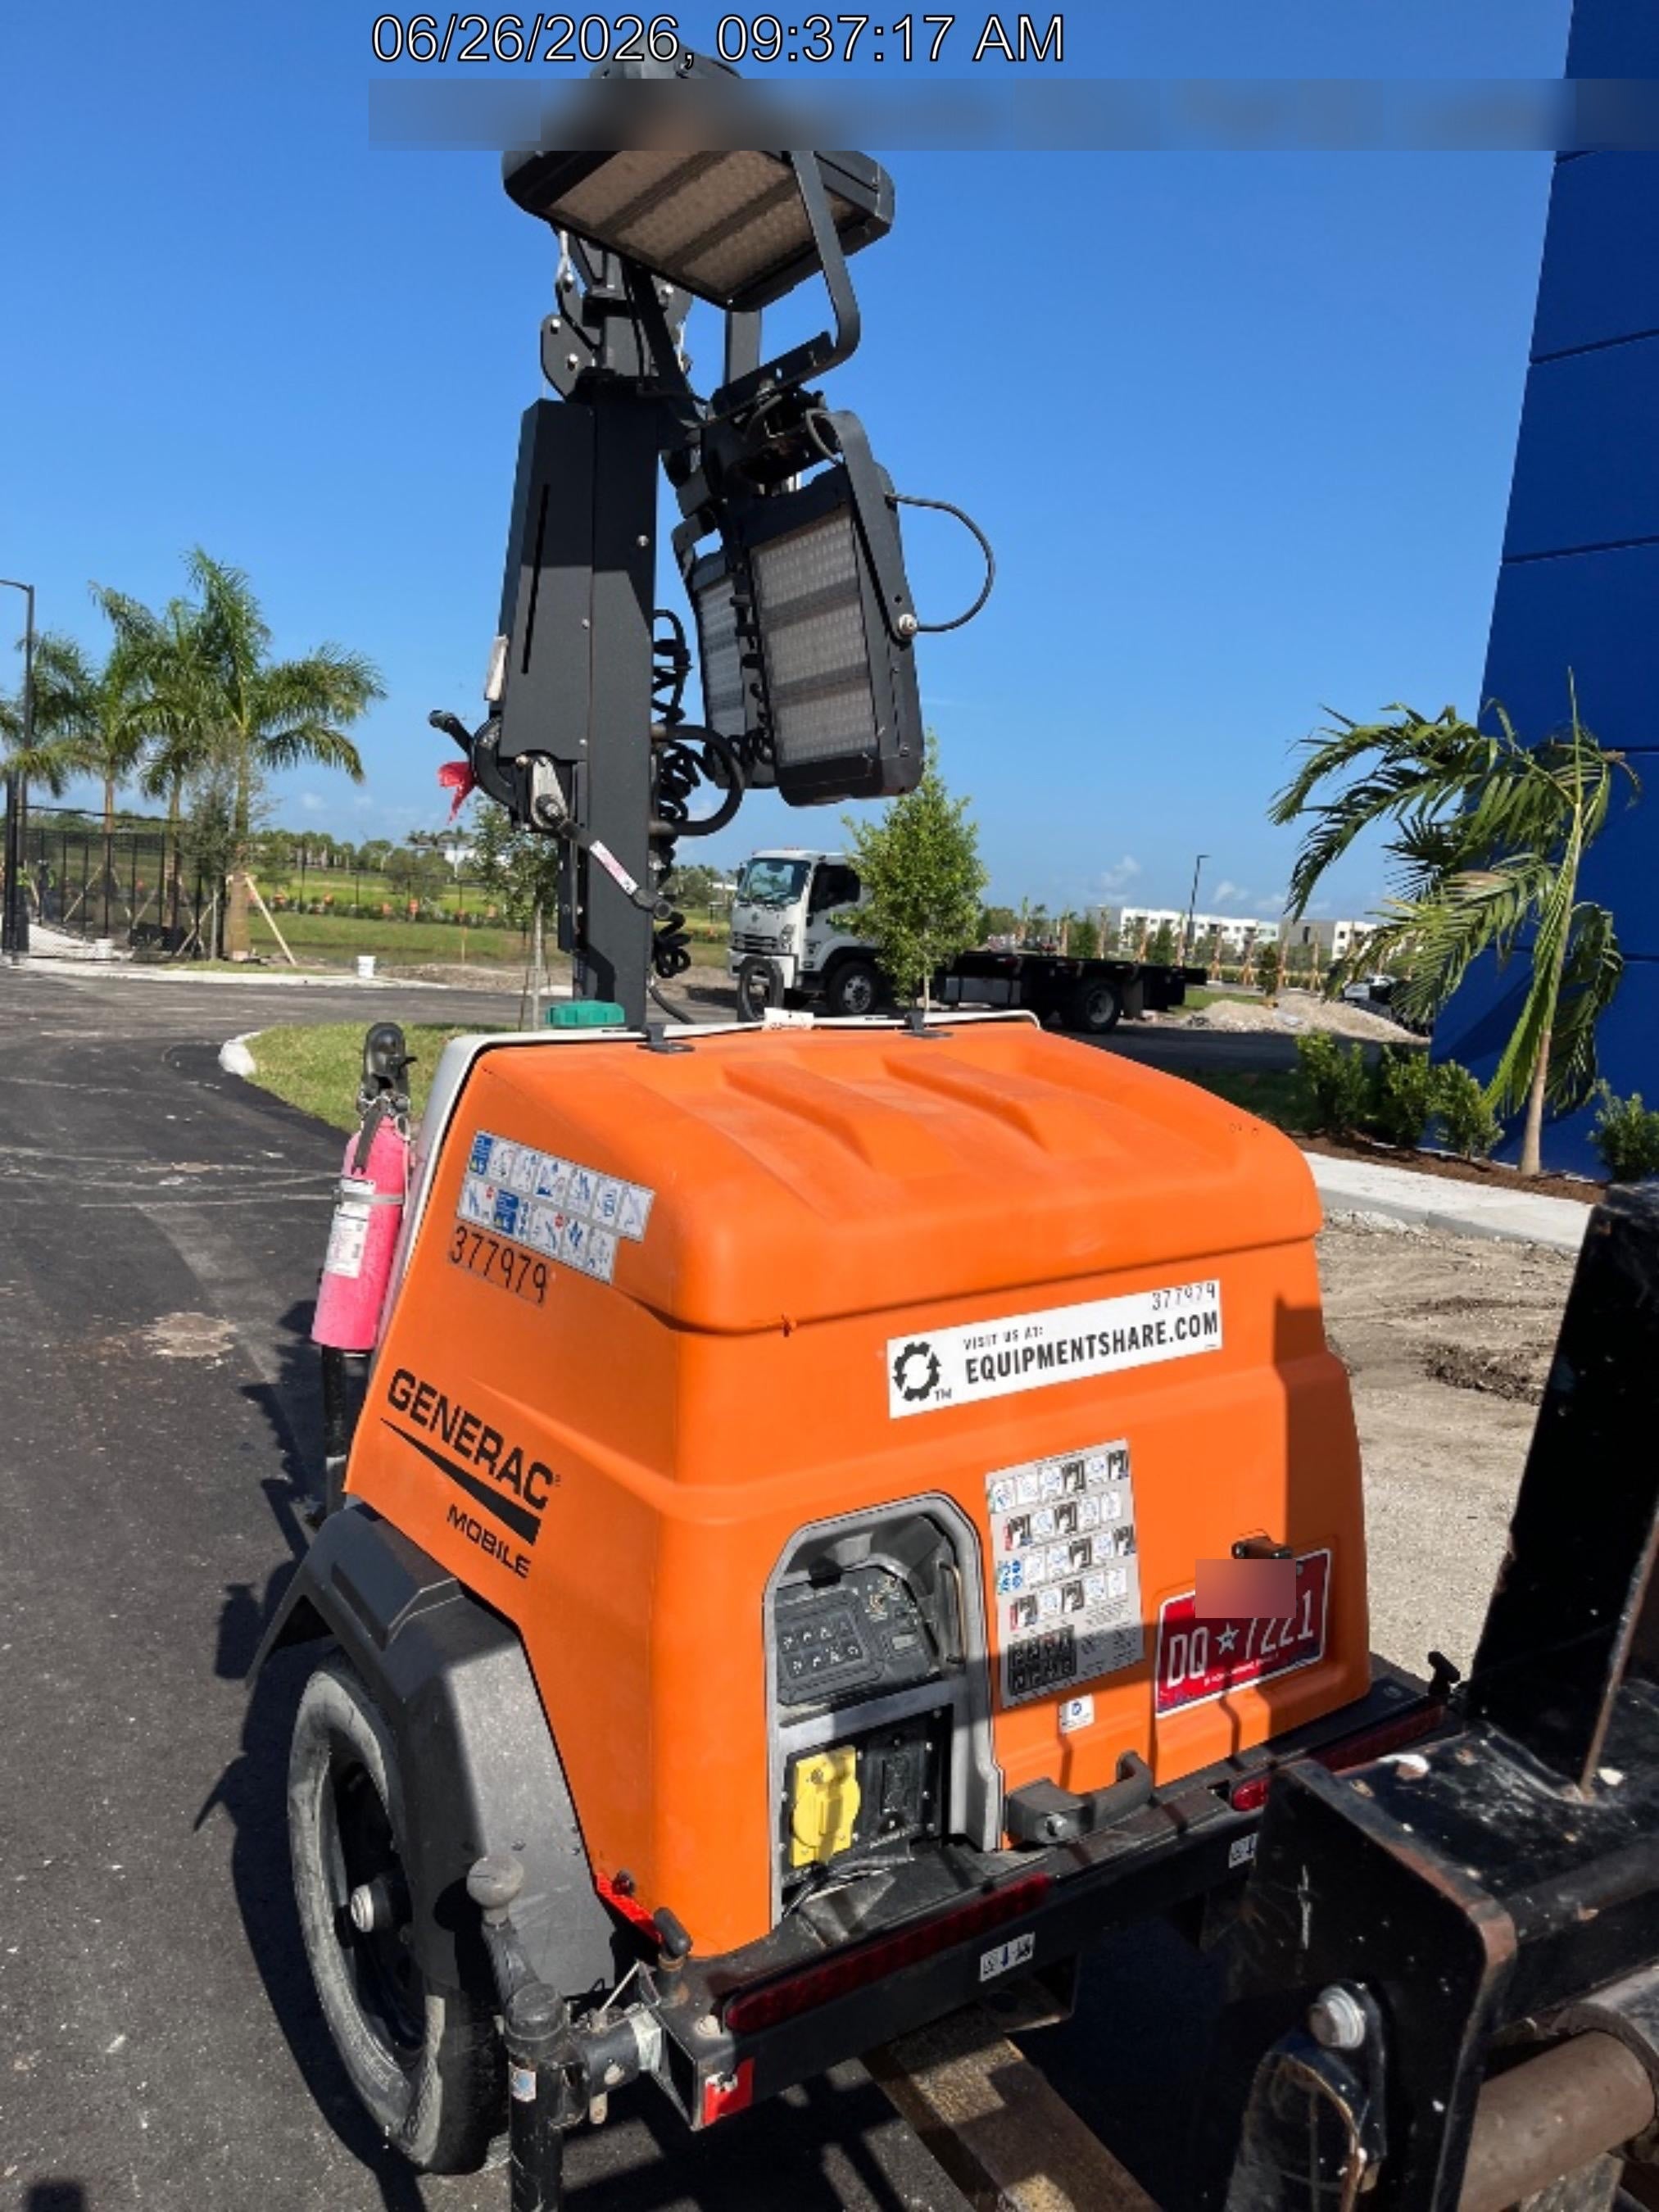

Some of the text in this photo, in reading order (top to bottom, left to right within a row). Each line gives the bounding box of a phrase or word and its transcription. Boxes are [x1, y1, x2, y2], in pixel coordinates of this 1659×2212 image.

[450, 1225, 546, 1304] 377979
[963, 1326, 1044, 1351] VISIT US AT:
[964, 1310, 1218, 1385] EQUIPMENTSHARE.COM
[387, 1367, 555, 1512] GENERAC
[446, 1503, 532, 1580] MOBILE
